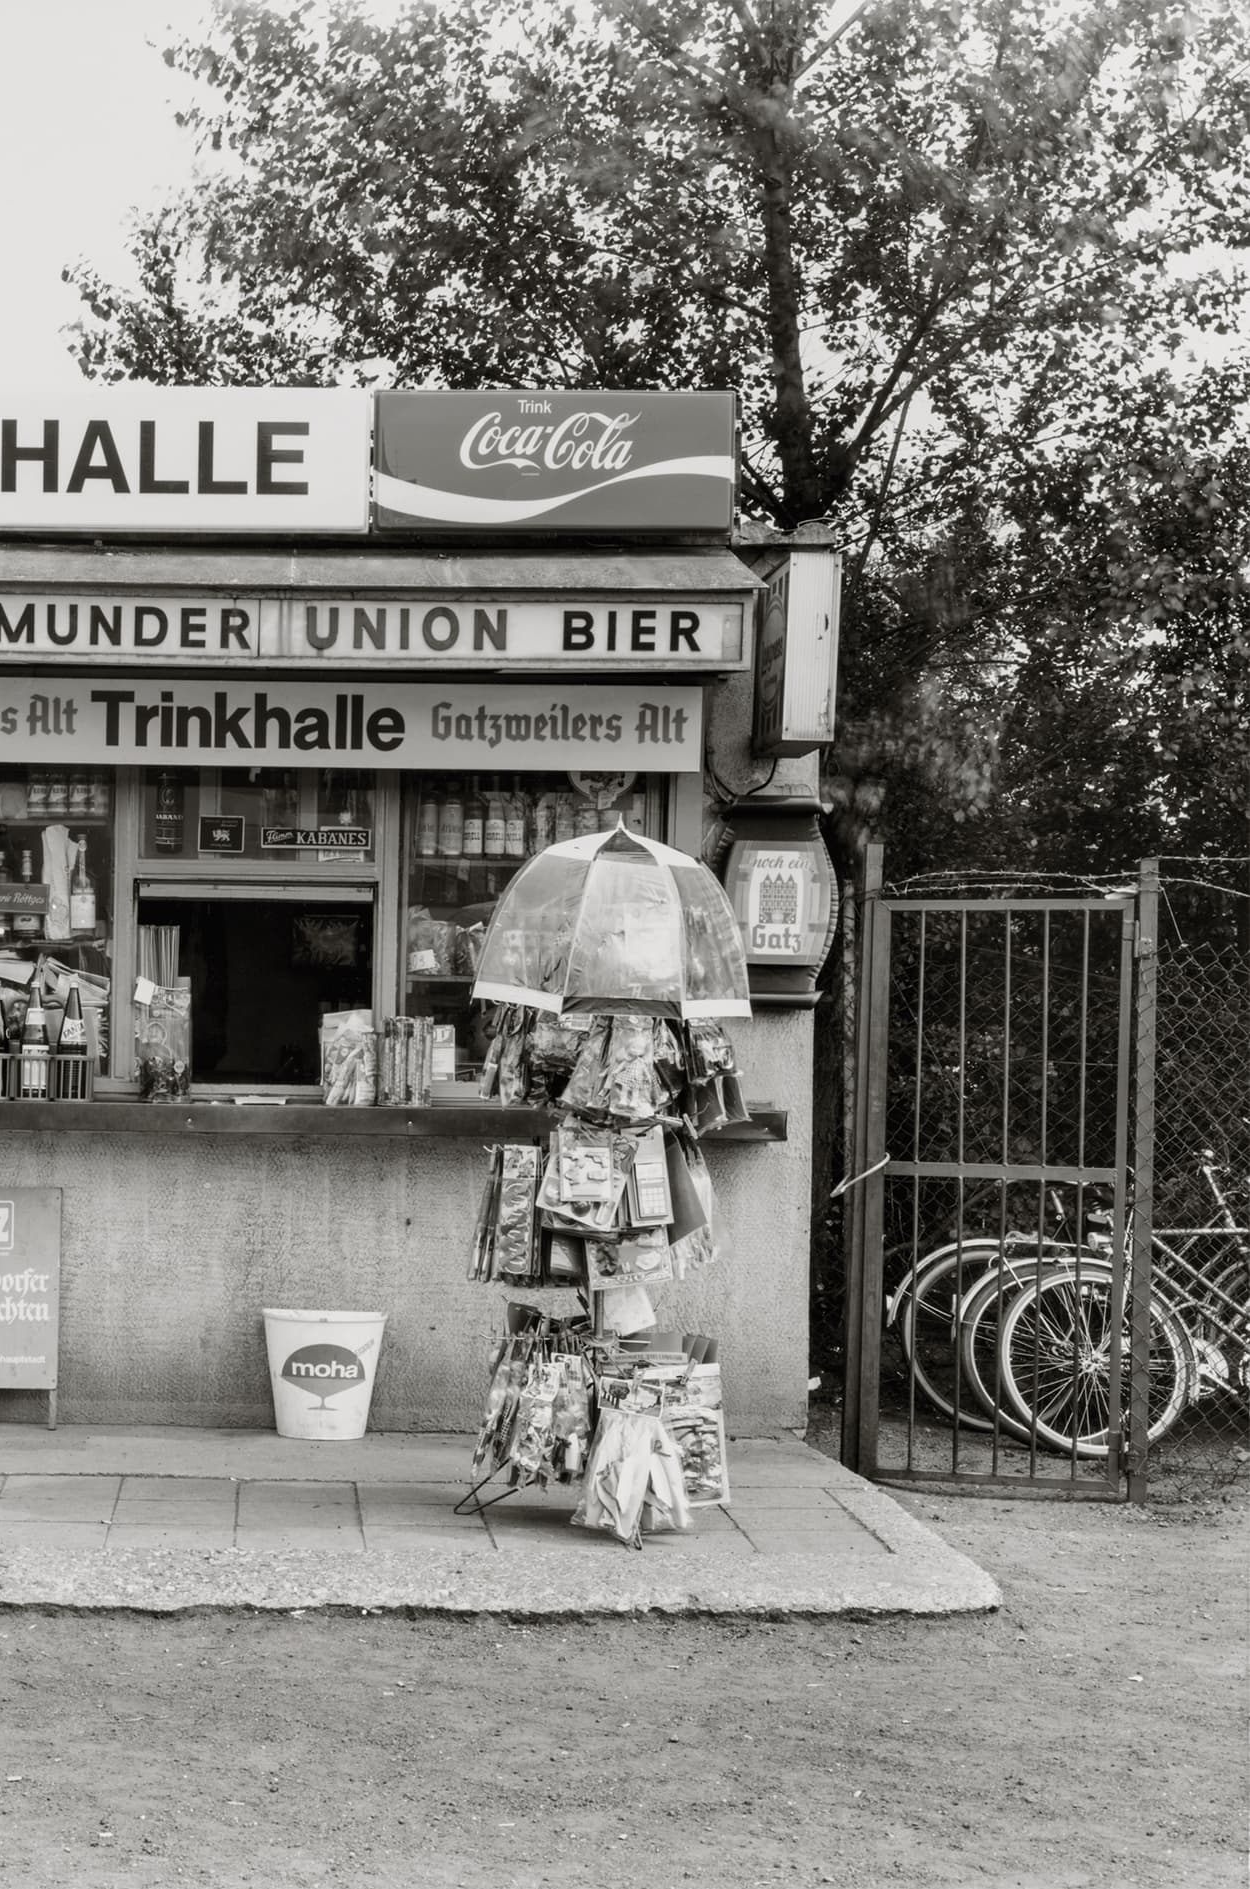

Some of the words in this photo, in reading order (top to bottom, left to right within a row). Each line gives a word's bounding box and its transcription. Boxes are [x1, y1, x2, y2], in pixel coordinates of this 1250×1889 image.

[517, 399, 552, 414] Trink
[459, 411, 642, 471] Coca-Cola
[306, 606, 508, 652] UNION
[562, 610, 702, 653] BIER
[27, 694, 79, 737] Alt
[90, 690, 406, 752] Trinkhalle
[430, 701, 623, 749] Gatzweilers
[635, 702, 690, 745] Alt
[296, 831, 367, 846] KABÄNES
[752, 855, 784, 869] noch
[751, 923, 801, 954] Gatz
[291, 1360, 359, 1379] moha
